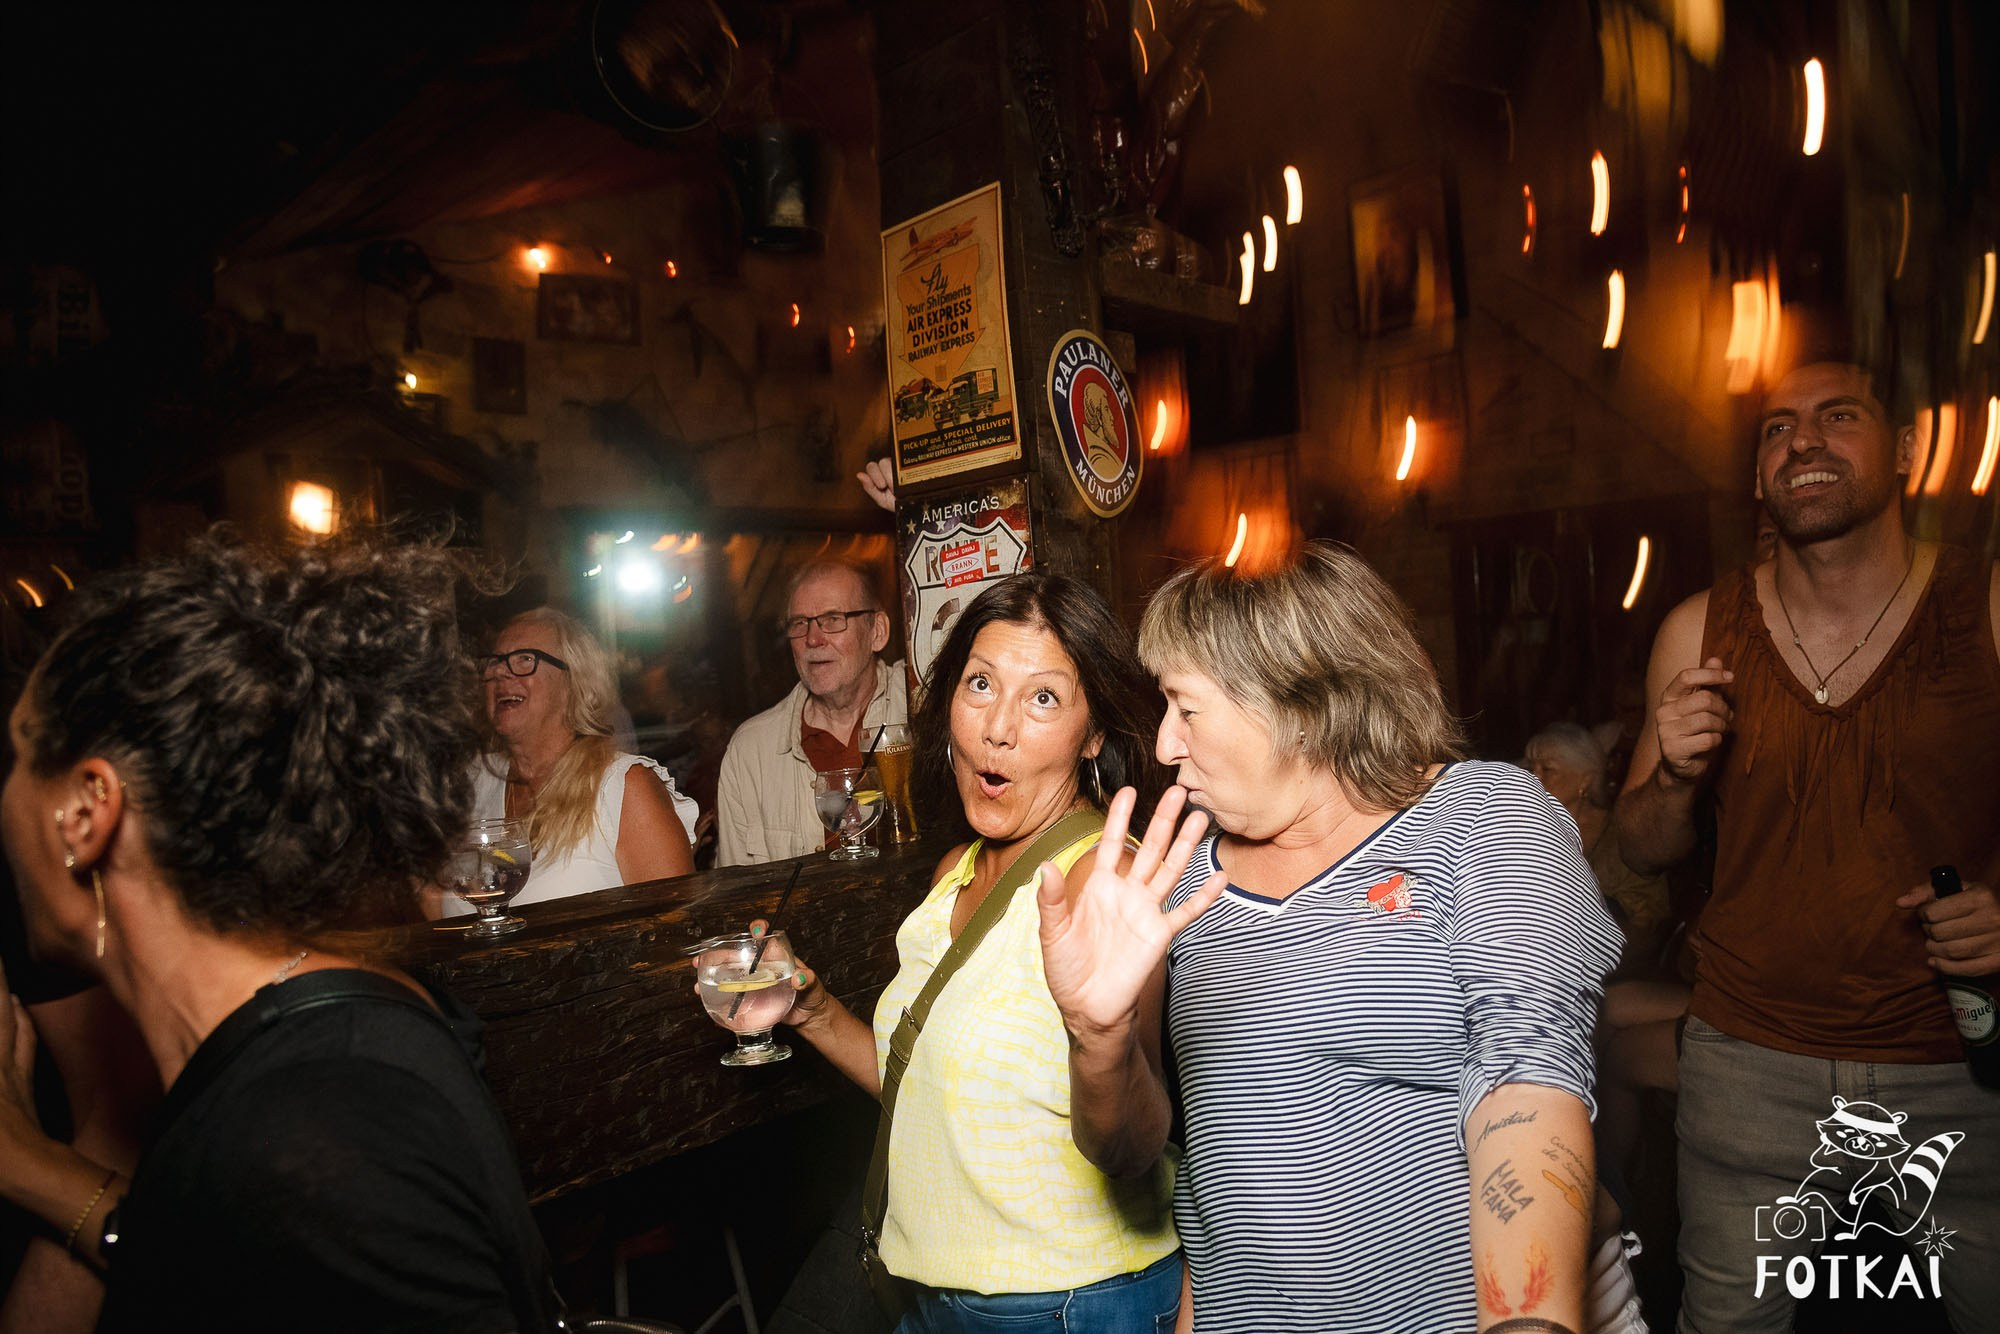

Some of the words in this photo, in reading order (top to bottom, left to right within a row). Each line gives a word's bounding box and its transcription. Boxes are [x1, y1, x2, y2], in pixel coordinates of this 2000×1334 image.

[921, 262, 949, 294] Fly
[906, 303, 925, 316] Your
[926, 284, 972, 310] Shipments
[907, 317, 925, 333] AIR
[927, 298, 973, 326] EXPRESS
[908, 344, 939, 362] RAILWAY
[940, 331, 976, 352] EXPRESS
[912, 317, 969, 347] DIVISION
[1055, 341, 1130, 409] PAULANER
[944, 427, 974, 440] SPECIAL
[976, 417, 1012, 432] DELIVERY
[1075, 459, 1136, 505] MÜNCHEN
[922, 496, 1000, 524] AMERICA'S
[951, 560, 973, 572] BRANN
[1956, 999, 1995, 1021] Miguel
[1473, 1110, 1539, 1153] Amistad
[1481, 1159, 1535, 1211] MALA
[1480, 1185, 1517, 1226] FAMA
